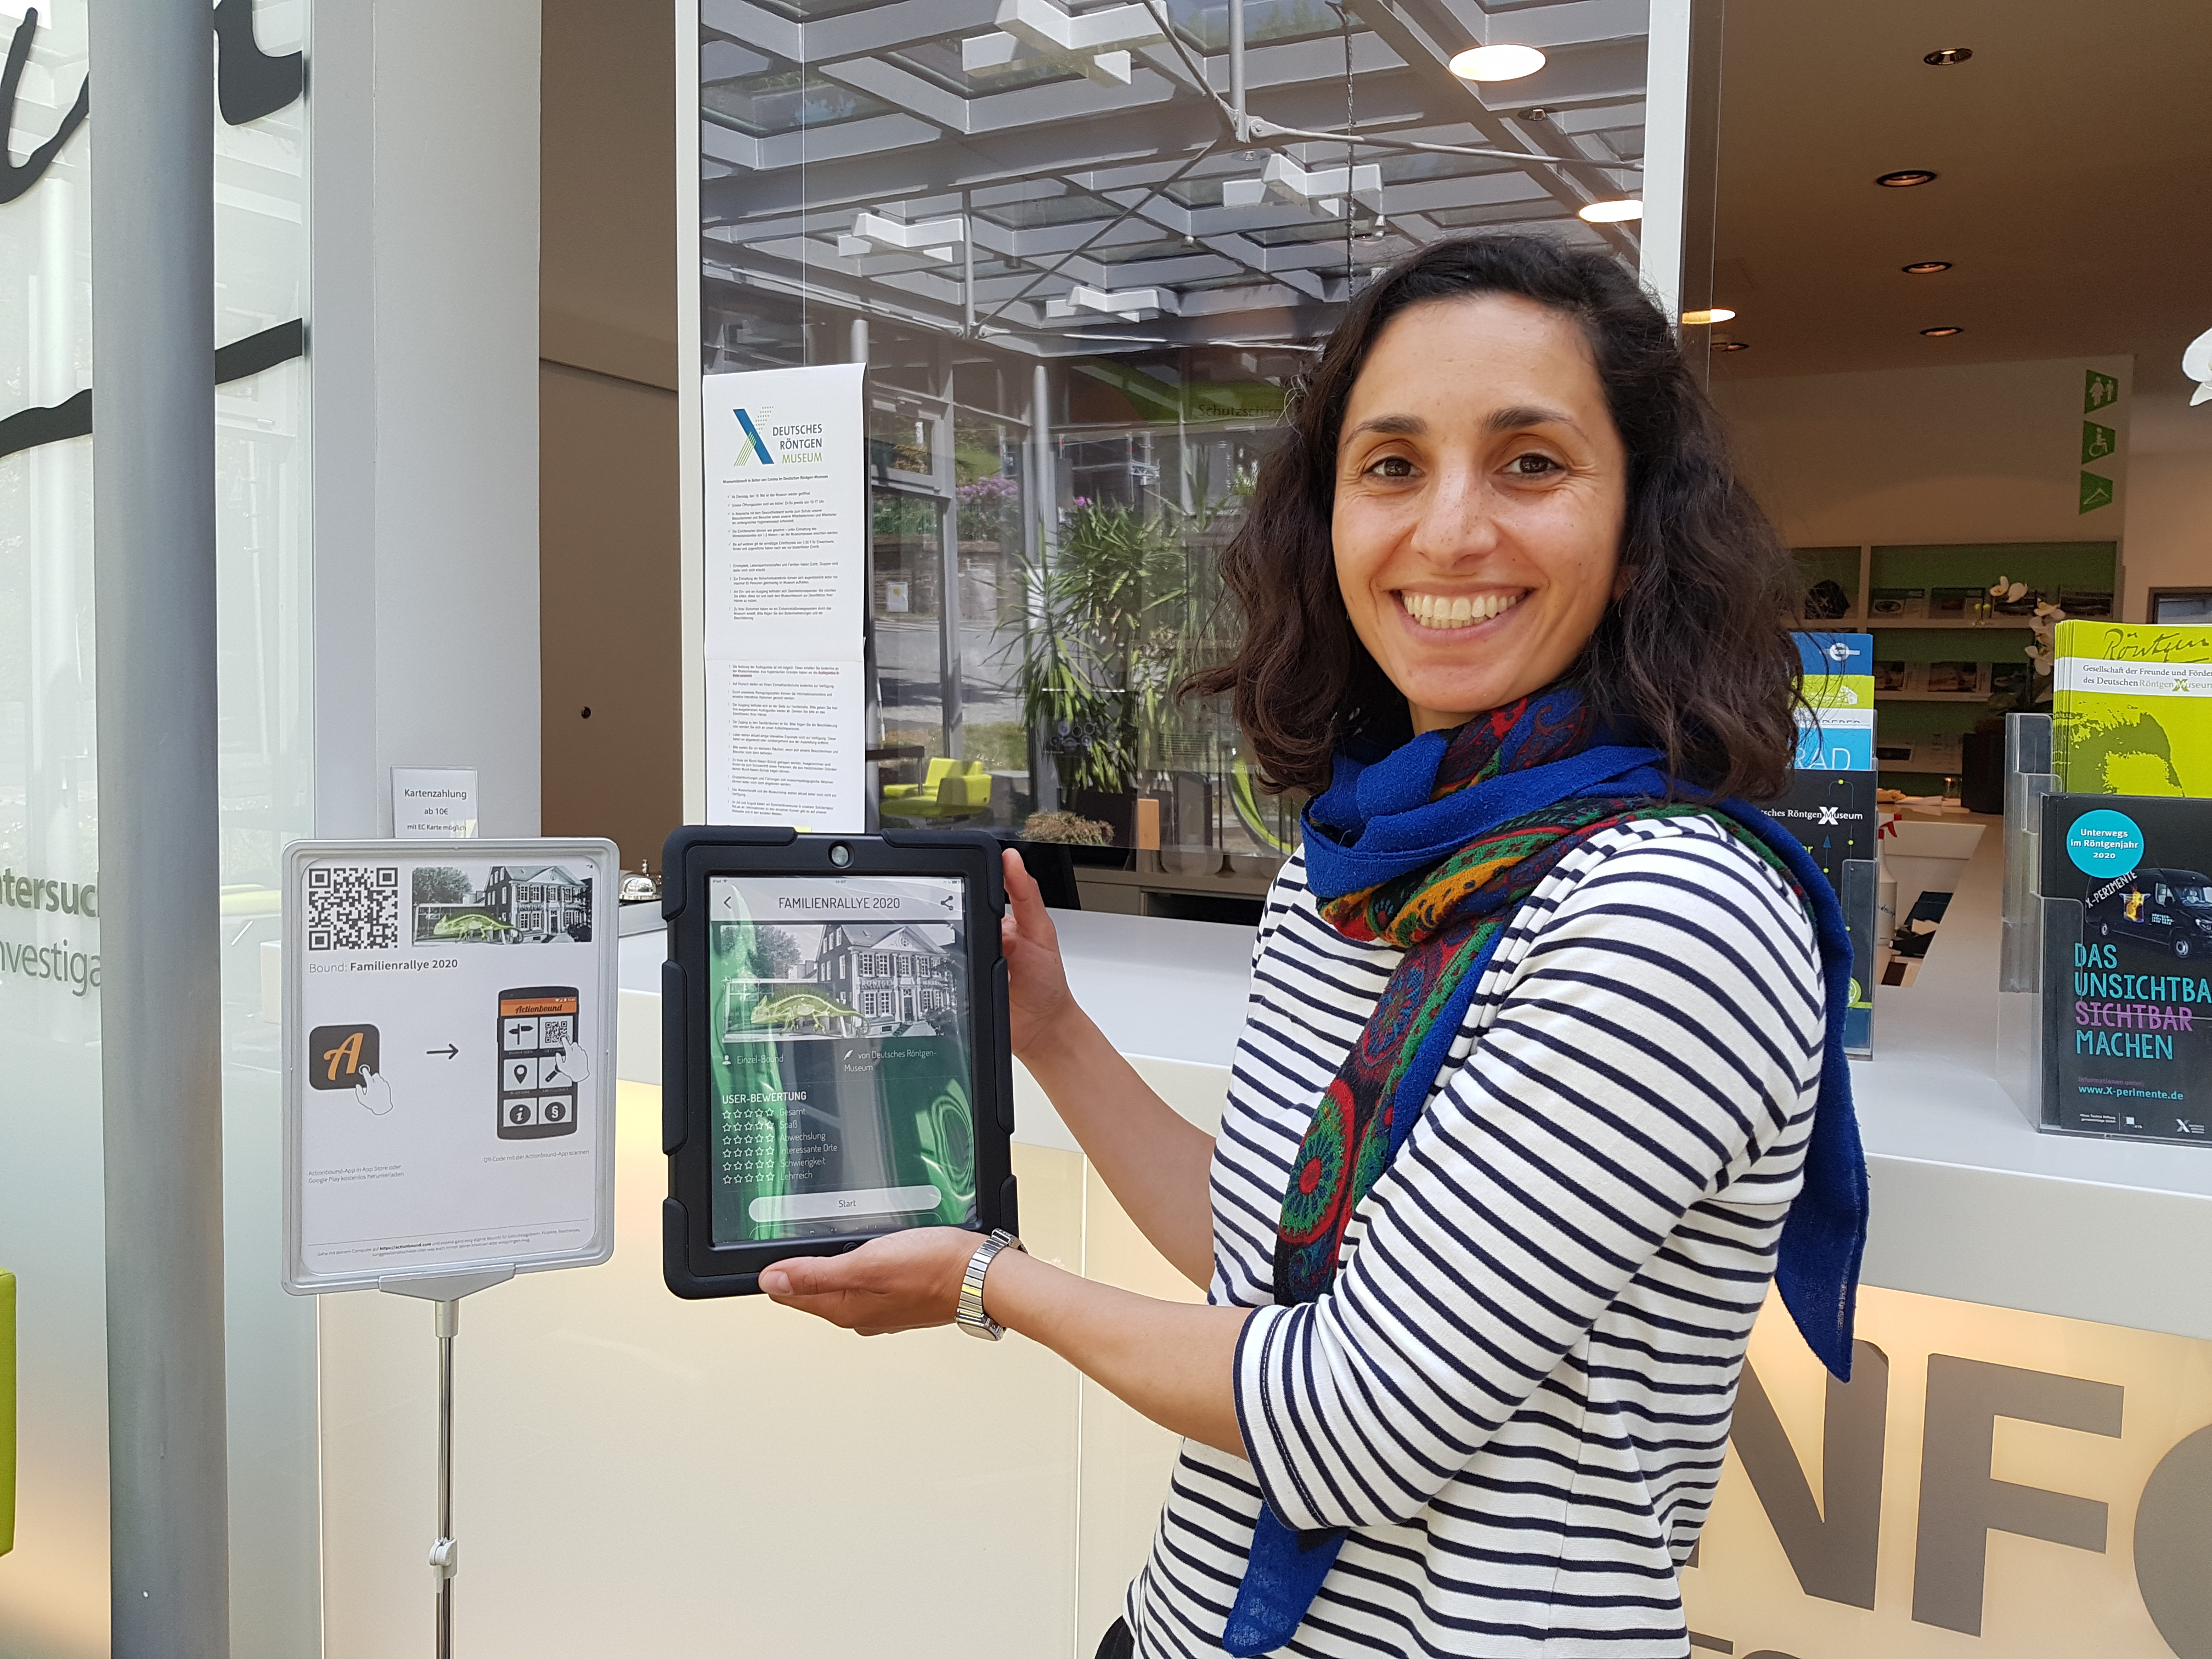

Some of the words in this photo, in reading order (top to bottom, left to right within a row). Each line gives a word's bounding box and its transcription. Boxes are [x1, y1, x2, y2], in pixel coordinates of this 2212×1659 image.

[772, 424, 822, 437] DEUTSCHES
[780, 437, 822, 450] RÖNTGEN
[782, 452, 822, 464] MUSEUM
[2083, 665, 2124, 674] Gesellschaft
[2097, 678, 2138, 686] Deutschen
[404, 789, 467, 800] Kartenzahlung
[2080, 829, 2128, 838] Unterwegs
[2084, 840, 2139, 849] Röntgenjahr
[0, 868, 100, 917] tersuc
[2085, 870, 2138, 909] X-PERIMENTE
[779, 897, 870, 909] FAMILIENRALLYE
[873, 897, 900, 909] 2020
[2075, 943, 2117, 969] DAS
[309, 962, 347, 973] Bound:
[350, 960, 430, 972] Familienrallye
[432, 959, 458, 969] 2020
[515, 1004, 563, 1014] Actionbound
[2075, 1002, 2193, 1031] SICHTBAR
[2076, 1030, 2174, 1060] MACHEN
[871, 1050, 905, 1059] Deutsches
[907, 1048, 937, 1059] Röntgen-
[737, 1054, 784, 1065] Einzel-Bound
[844, 1064, 873, 1072] Museum
[723, 1091, 807, 1104] USER-BEWERTUNG
[2078, 1086, 2184, 1101] www.X-perimente.de
[780, 1108, 806, 1116] Gesamt
[780, 1120, 798, 1130] Spaß
[780, 1132, 826, 1143] Abwechslung
[780, 1145, 822, 1155] Interessante
[823, 1143, 838, 1153] Orte
[780, 1157, 826, 1169] Schwierigkeit
[780, 1171, 813, 1181] Lehrreich
[838, 1199, 856, 1208] Start
